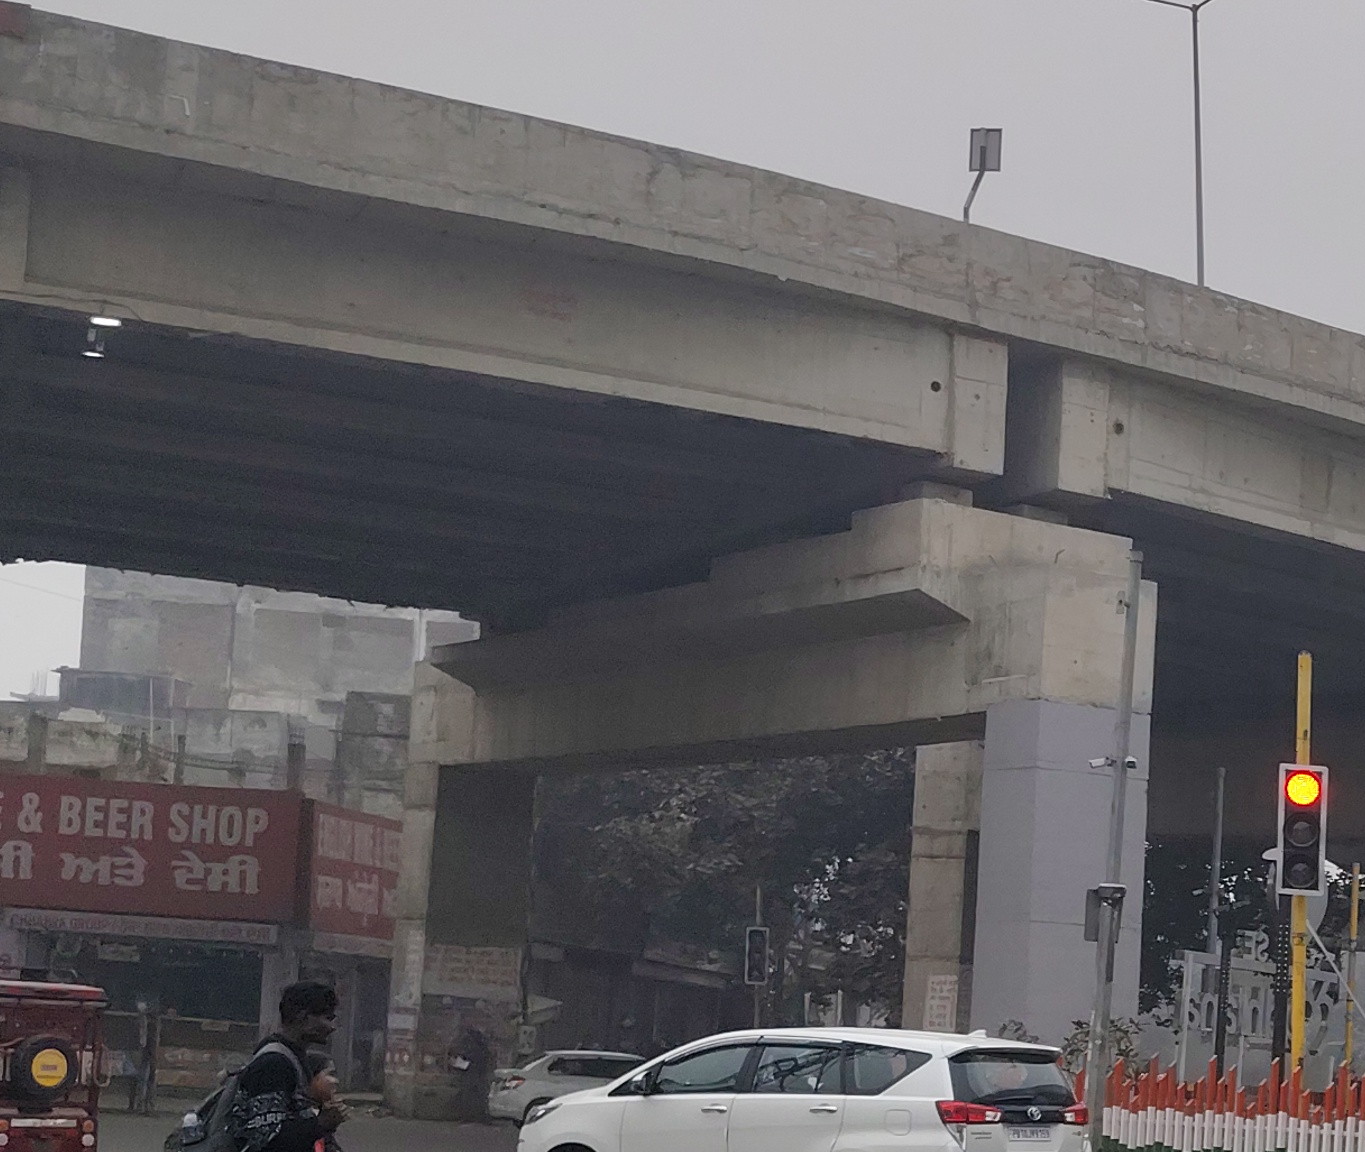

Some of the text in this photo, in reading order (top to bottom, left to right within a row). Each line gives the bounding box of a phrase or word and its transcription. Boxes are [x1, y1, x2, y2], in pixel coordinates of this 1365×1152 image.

[17, 792, 43, 834] &
[58, 795, 154, 841] BEER
[168, 802, 269, 847] SHOP
[59, 845, 148, 888] ਅਤੇ
[171, 849, 261, 895] ਦੇਸੀ
